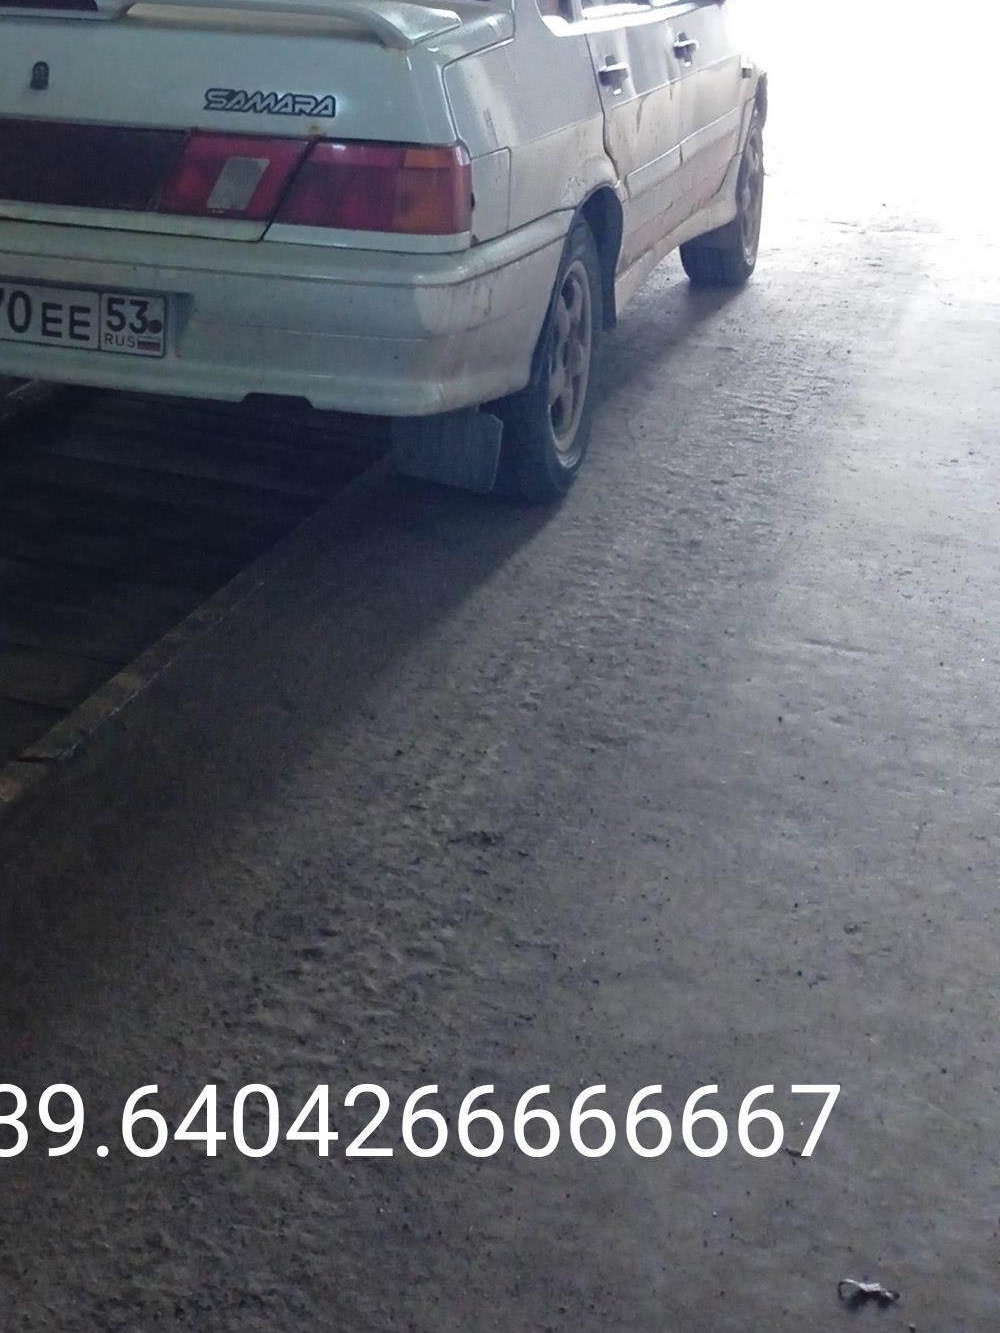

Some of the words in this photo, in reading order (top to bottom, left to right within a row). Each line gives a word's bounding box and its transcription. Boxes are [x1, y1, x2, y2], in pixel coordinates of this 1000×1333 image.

[203, 88, 336, 118] SAMARA
[105, 297, 149, 334] 53
[104, 333, 136, 348] RUS
